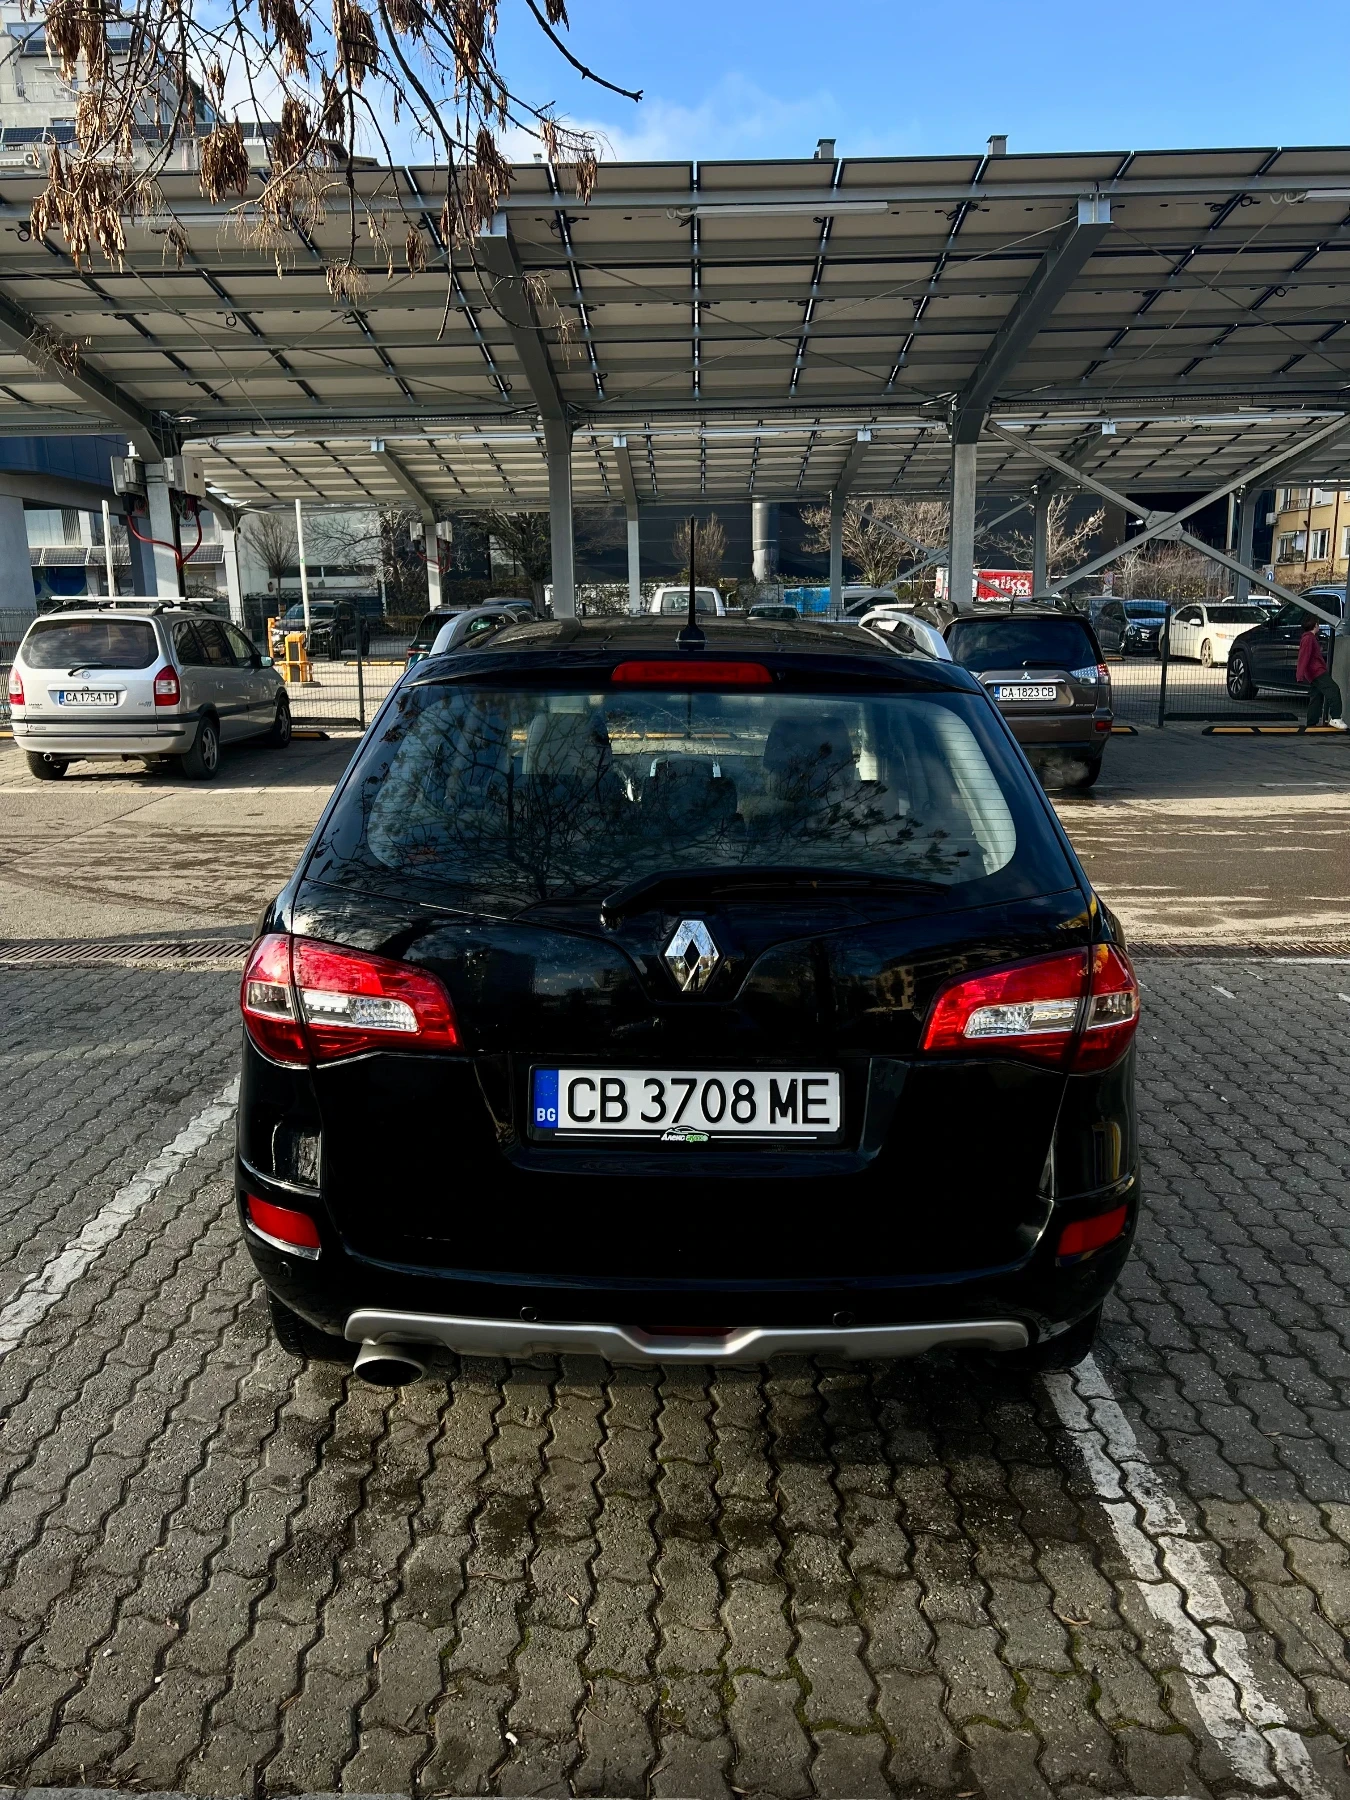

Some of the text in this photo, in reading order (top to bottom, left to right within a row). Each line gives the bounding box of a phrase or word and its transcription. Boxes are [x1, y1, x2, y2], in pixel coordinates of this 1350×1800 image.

[102, 692, 115, 702] TP
[1001, 687, 1014, 698] CA
[1017, 687, 1040, 698] 1823
[1041, 686, 1054, 697] CB
[567, 1076, 830, 1125] CB 3708 ME
[536, 1107, 556, 1122] BG
